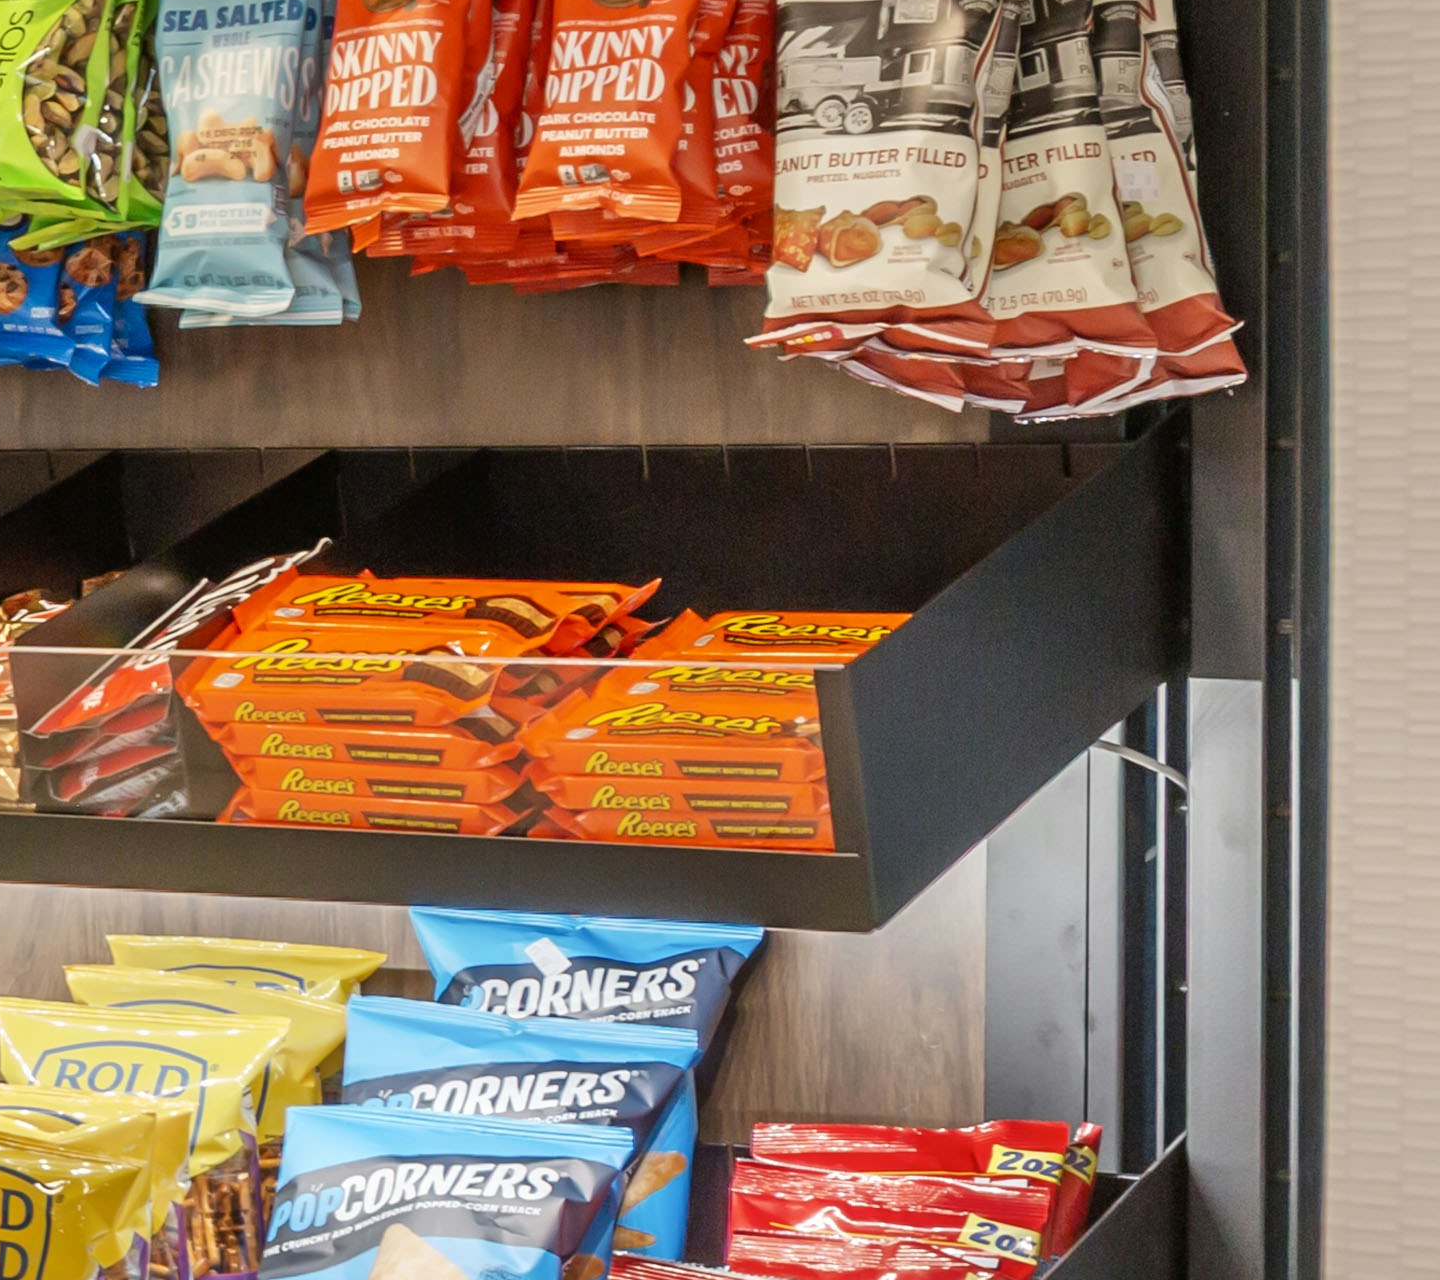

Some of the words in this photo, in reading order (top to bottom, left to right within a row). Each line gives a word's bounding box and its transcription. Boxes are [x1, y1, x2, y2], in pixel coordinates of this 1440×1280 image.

[162, 6, 210, 32] SEA
[212, 30, 254, 47] WHOLE
[549, 26, 675, 71] SKINNY
[332, 30, 443, 81] SKINNY
[162, 44, 304, 105] CASHEWS
[543, 58, 666, 107] DIPPED
[326, 65, 438, 118] DIPPED
[355, 116, 430, 129] CHOCOLATE
[573, 112, 656, 125] CHOCOLATE
[322, 132, 372, 149] PEANUT
[373, 131, 423, 145] BUTTER
[541, 129, 591, 143] PEANUT
[339, 147, 400, 165] ALMONDS
[560, 144, 625, 158] ALMONDS
[828, 148, 899, 171] BUTTER
[905, 145, 967, 169] FILLED
[1046, 142, 1103, 169] FILLED
[806, 171, 850, 185] PRETZEL
[791, 294, 815, 309] NET
[817, 293, 838, 307] WT
[841, 292, 861, 305] 2.5
[863, 291, 880, 304] OZ
[292, 583, 476, 611] Reese's
[260, 733, 335, 760] Reese's
[281, 767, 356, 795] Reese's
[460, 958, 700, 1020] CORNERS
[653, 1006, 692, 1017] SNACK
[52, 1057, 190, 1099] ROLD
[997, 1151, 1018, 1170] 2
[267, 1163, 560, 1242] POPCORNERS
[281, 1233, 331, 1252] CRUNCHY
[332, 1224, 353, 1239] AND
[499, 1204, 541, 1216] SNACK
[969, 1222, 998, 1244] 2
